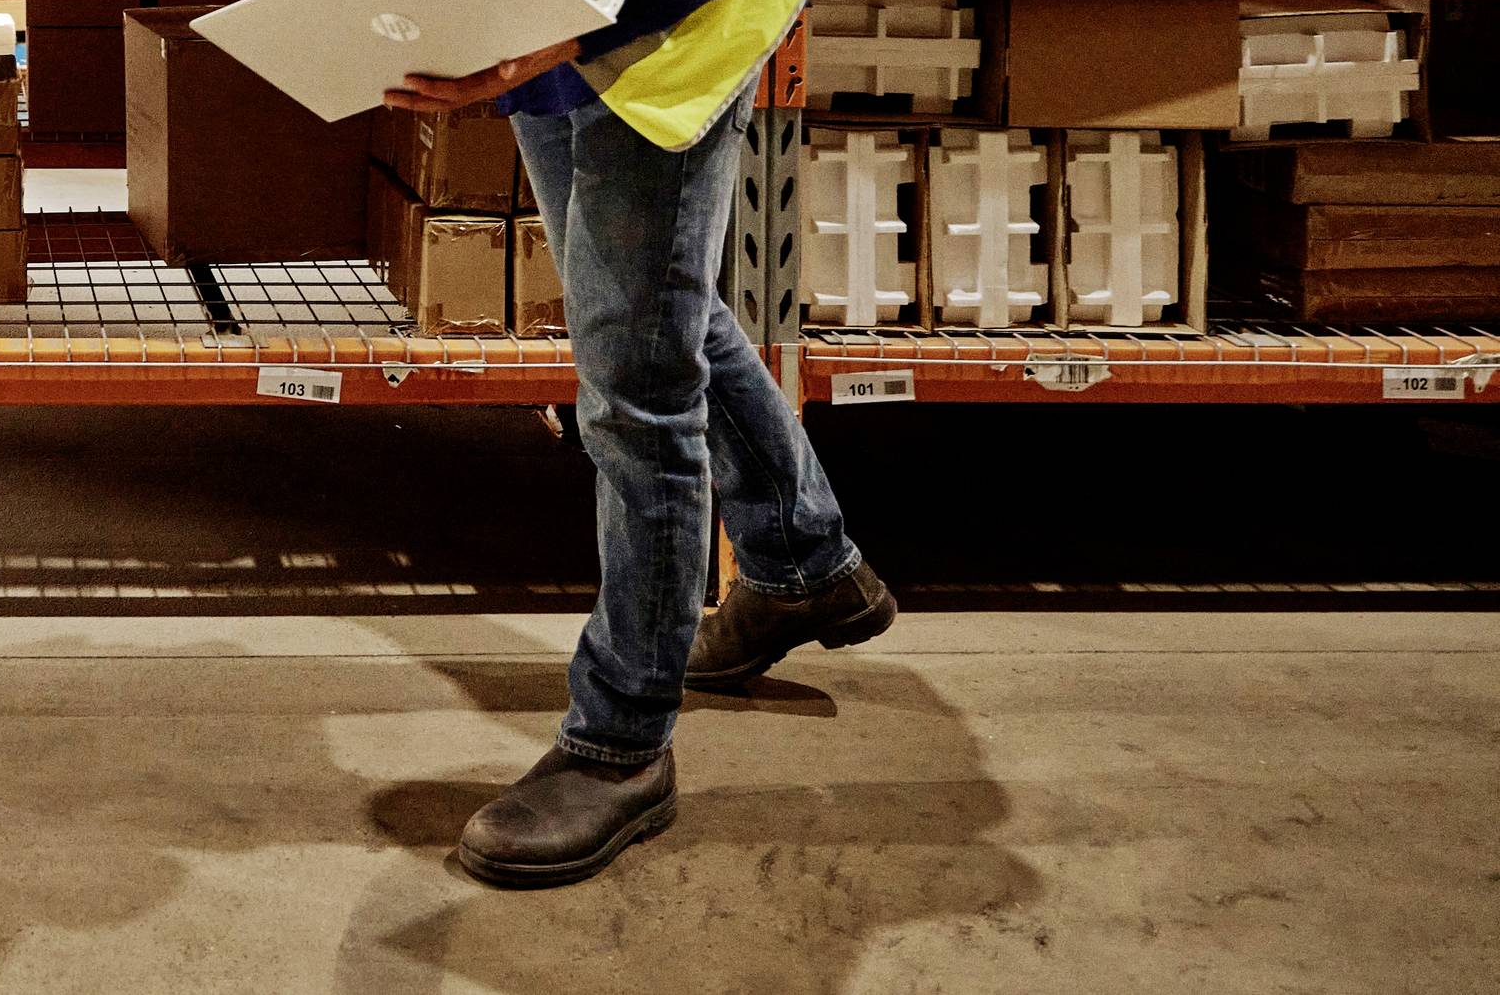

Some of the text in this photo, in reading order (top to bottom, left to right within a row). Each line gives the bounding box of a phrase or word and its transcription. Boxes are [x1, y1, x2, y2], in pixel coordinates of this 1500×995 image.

[279, 382, 305, 397] 103
[848, 382, 875, 397] 101
[1402, 377, 1429, 391] 102
